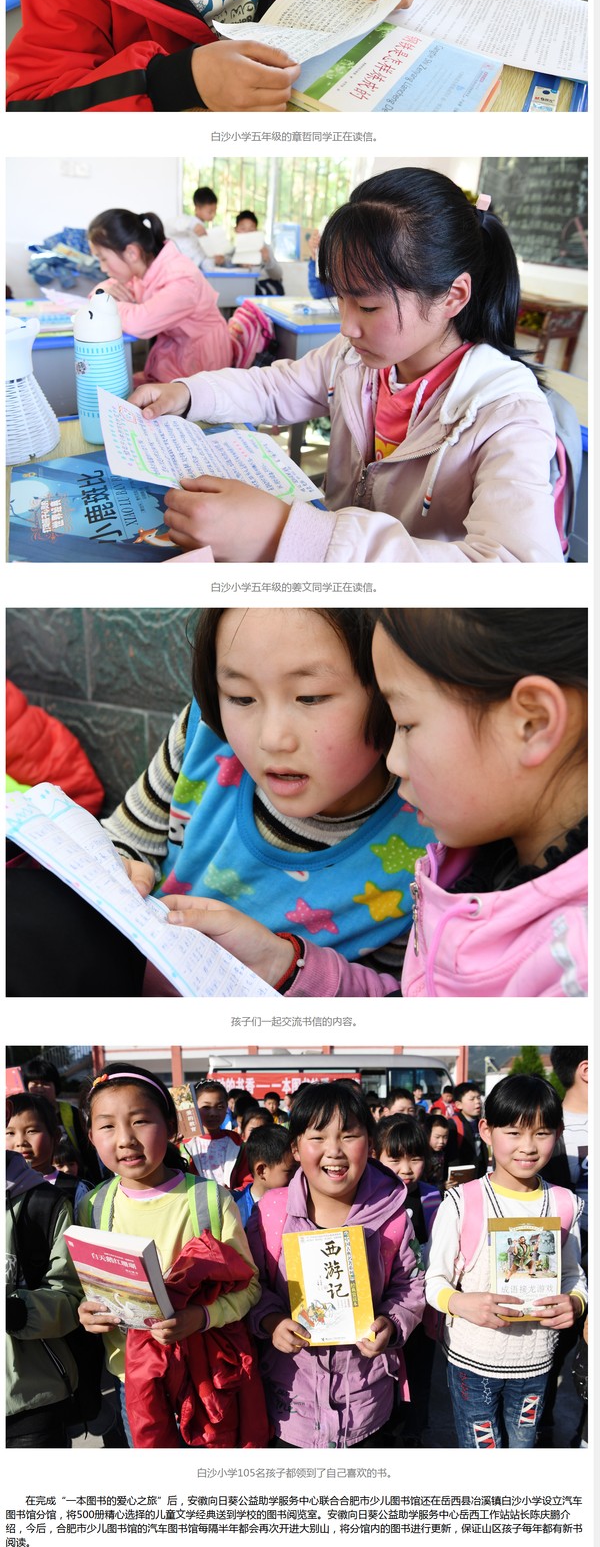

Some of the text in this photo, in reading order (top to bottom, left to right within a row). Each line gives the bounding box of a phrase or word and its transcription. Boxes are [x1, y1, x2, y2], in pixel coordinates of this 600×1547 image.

[349, 35, 422, 101] 钢铁是怎样炼成的
[77, 470, 123, 544] 小鹿斑比
[119, 506, 138, 527] XIAO
[320, 1240, 350, 1299] 西游记
